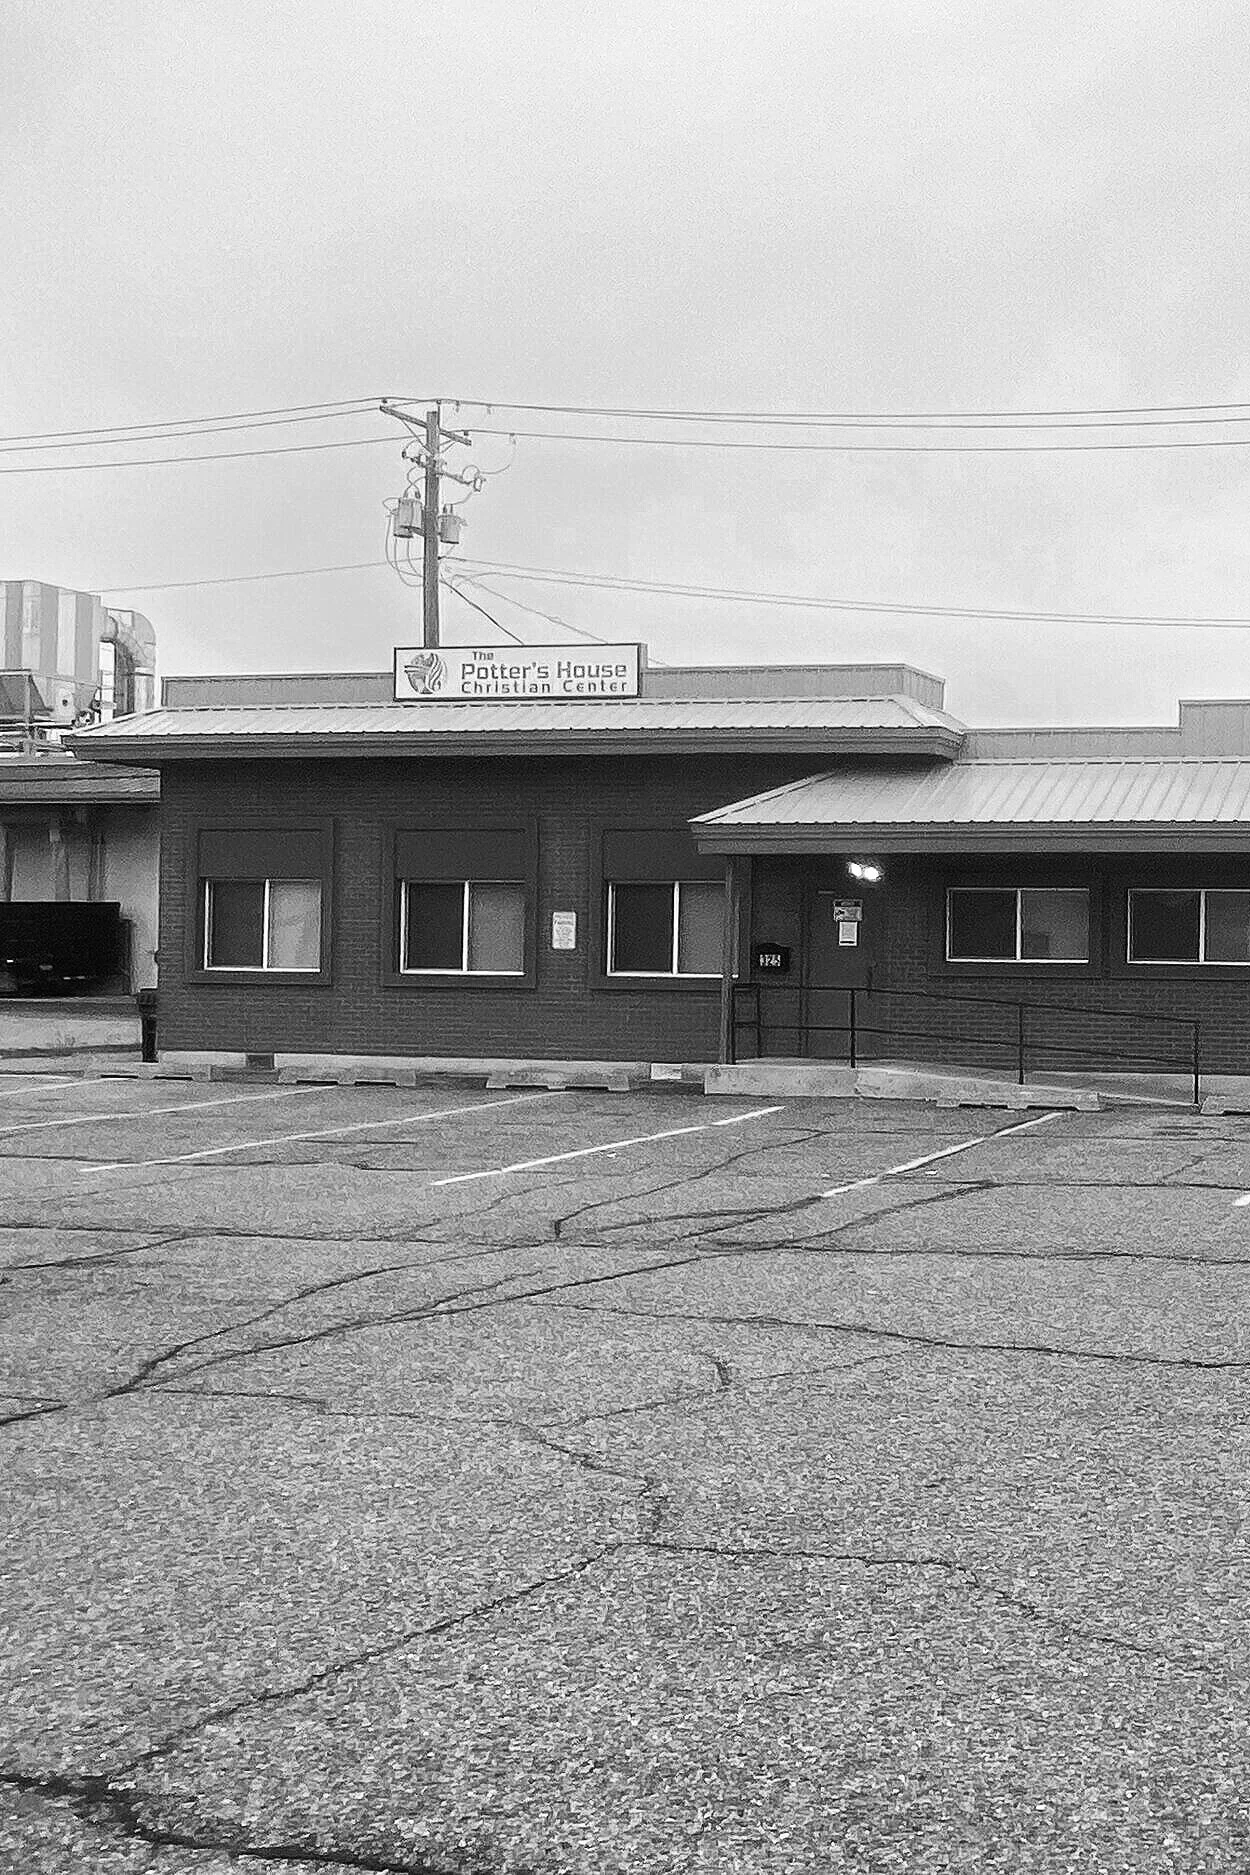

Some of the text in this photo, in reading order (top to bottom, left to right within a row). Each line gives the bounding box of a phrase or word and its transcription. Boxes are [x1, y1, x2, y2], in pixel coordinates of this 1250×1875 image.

[472, 651, 494, 661] The
[461, 661, 627, 680] Potter's House
[461, 679, 627, 694] Christian Center
